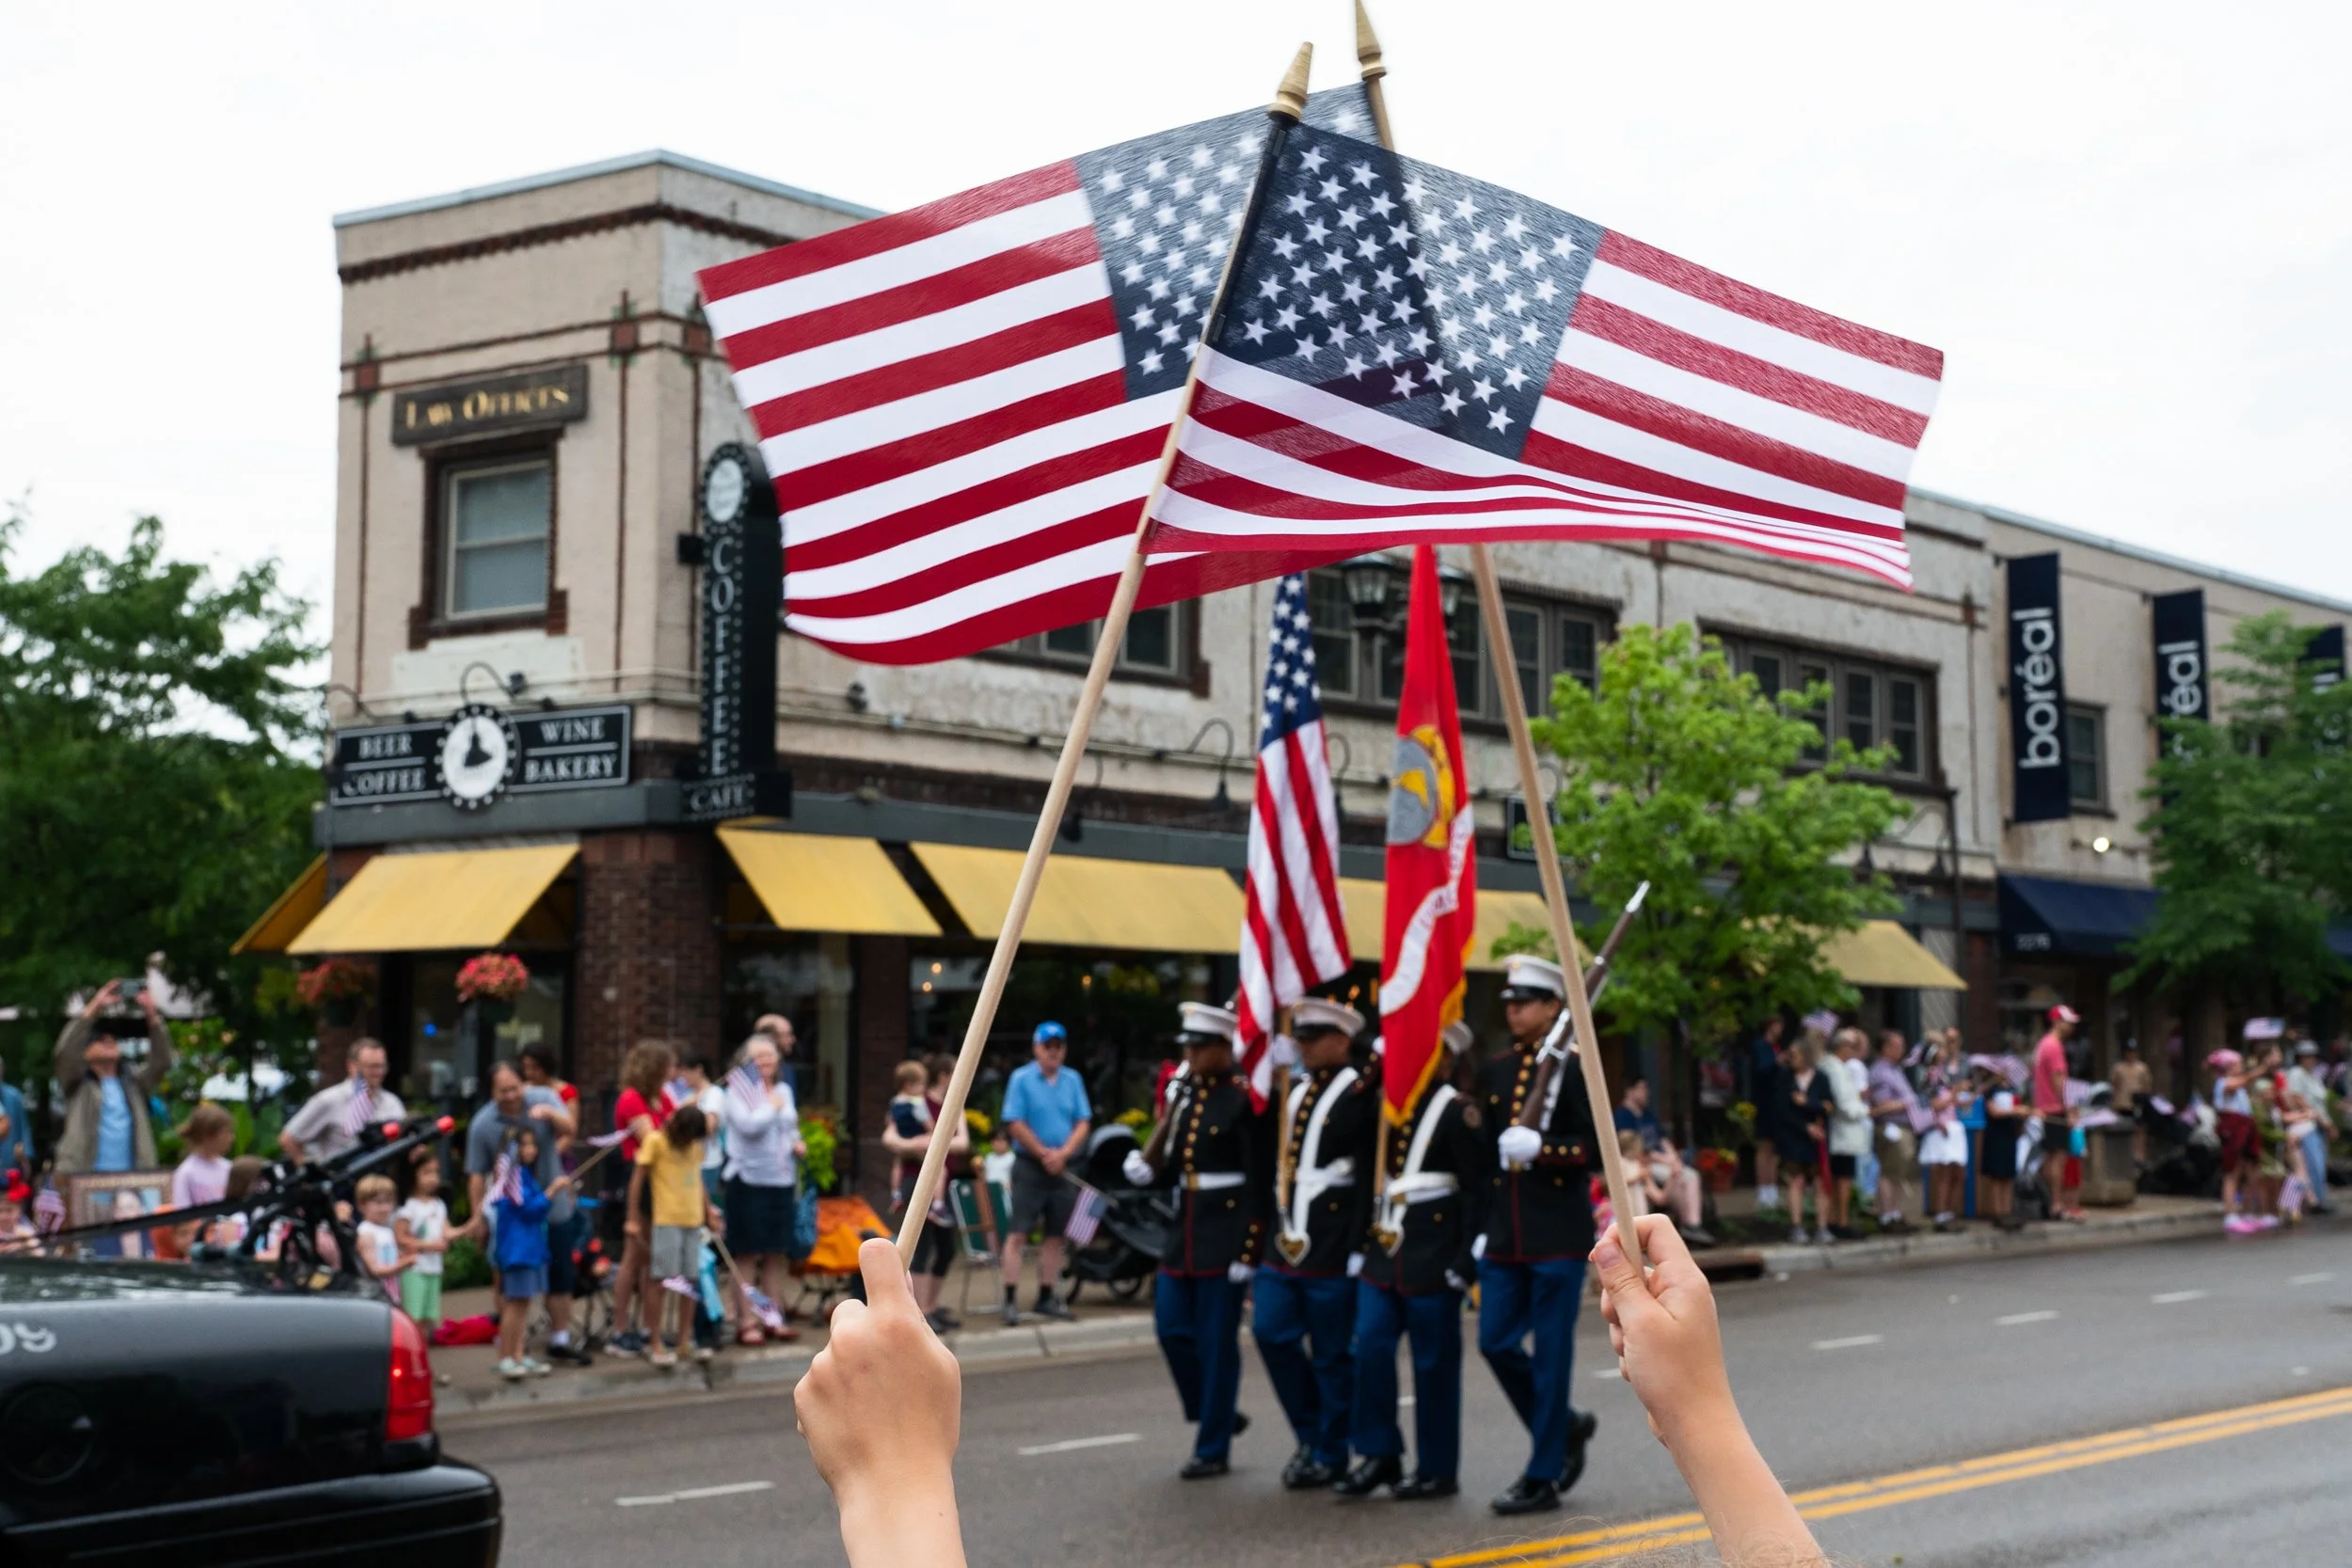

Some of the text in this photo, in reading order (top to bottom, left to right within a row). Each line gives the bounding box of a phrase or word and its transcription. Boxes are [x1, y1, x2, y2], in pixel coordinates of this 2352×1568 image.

[710, 534, 735, 777] COFFEE
[2011, 607, 2062, 769] boréal
[539, 715, 606, 744] WINE
[358, 732, 413, 759] BEER
[342, 767, 426, 797] COFFEE
[523, 752, 617, 783] BAKERY
